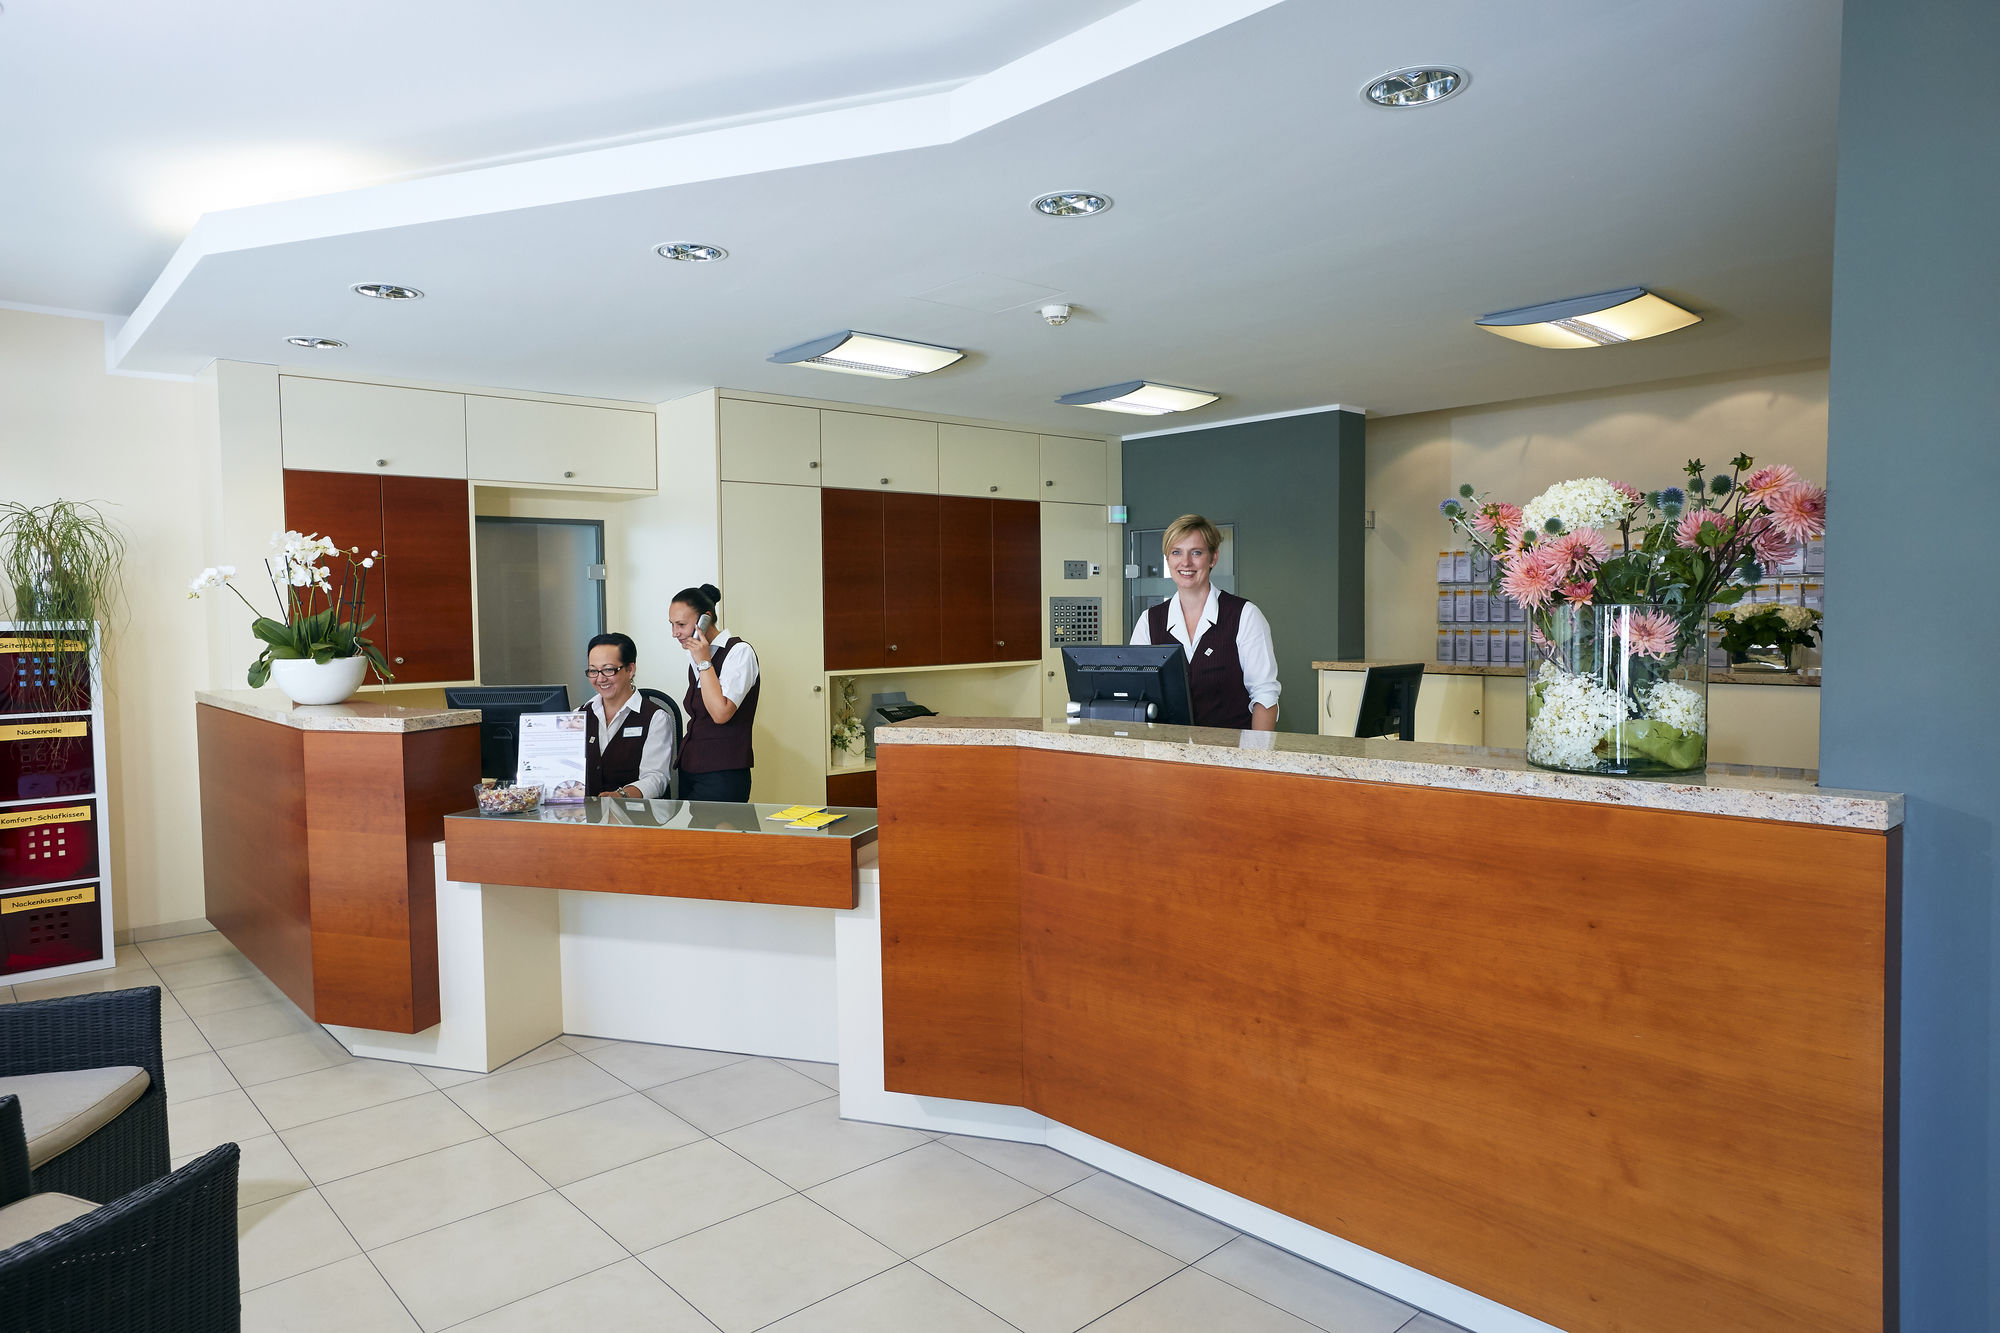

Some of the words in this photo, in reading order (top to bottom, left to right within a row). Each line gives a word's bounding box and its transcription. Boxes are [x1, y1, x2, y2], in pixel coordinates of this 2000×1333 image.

[0, 812, 85, 825] Komfort-Schlafkissen
[12, 898, 63, 908] Nackenkissen
[66, 894, 83, 902] groß
